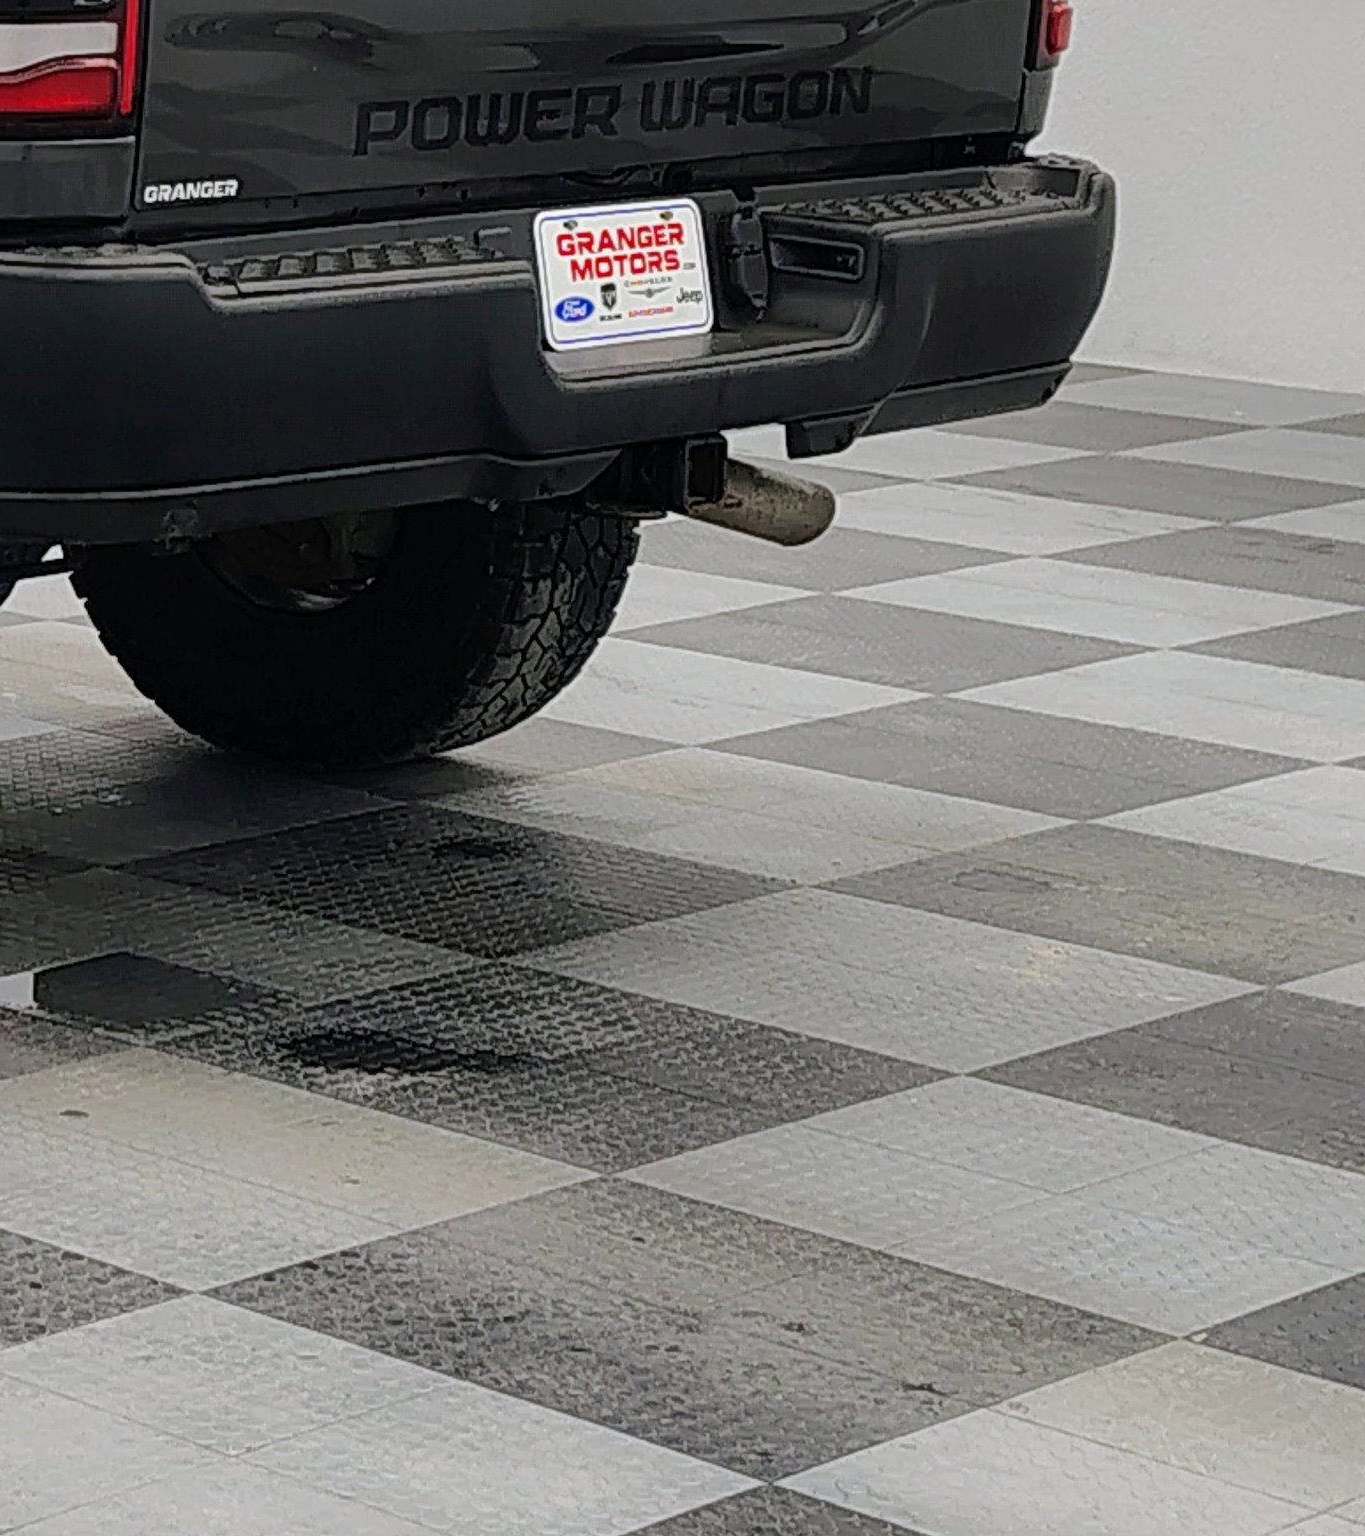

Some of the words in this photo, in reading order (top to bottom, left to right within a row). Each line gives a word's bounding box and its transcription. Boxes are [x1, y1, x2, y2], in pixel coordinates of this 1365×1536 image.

[352, 86, 622, 156] POWER
[639, 66, 872, 132] WAGON
[144, 179, 238, 203] GRANGER
[556, 223, 684, 256] GRANGER
[570, 250, 680, 282] MOTORS
